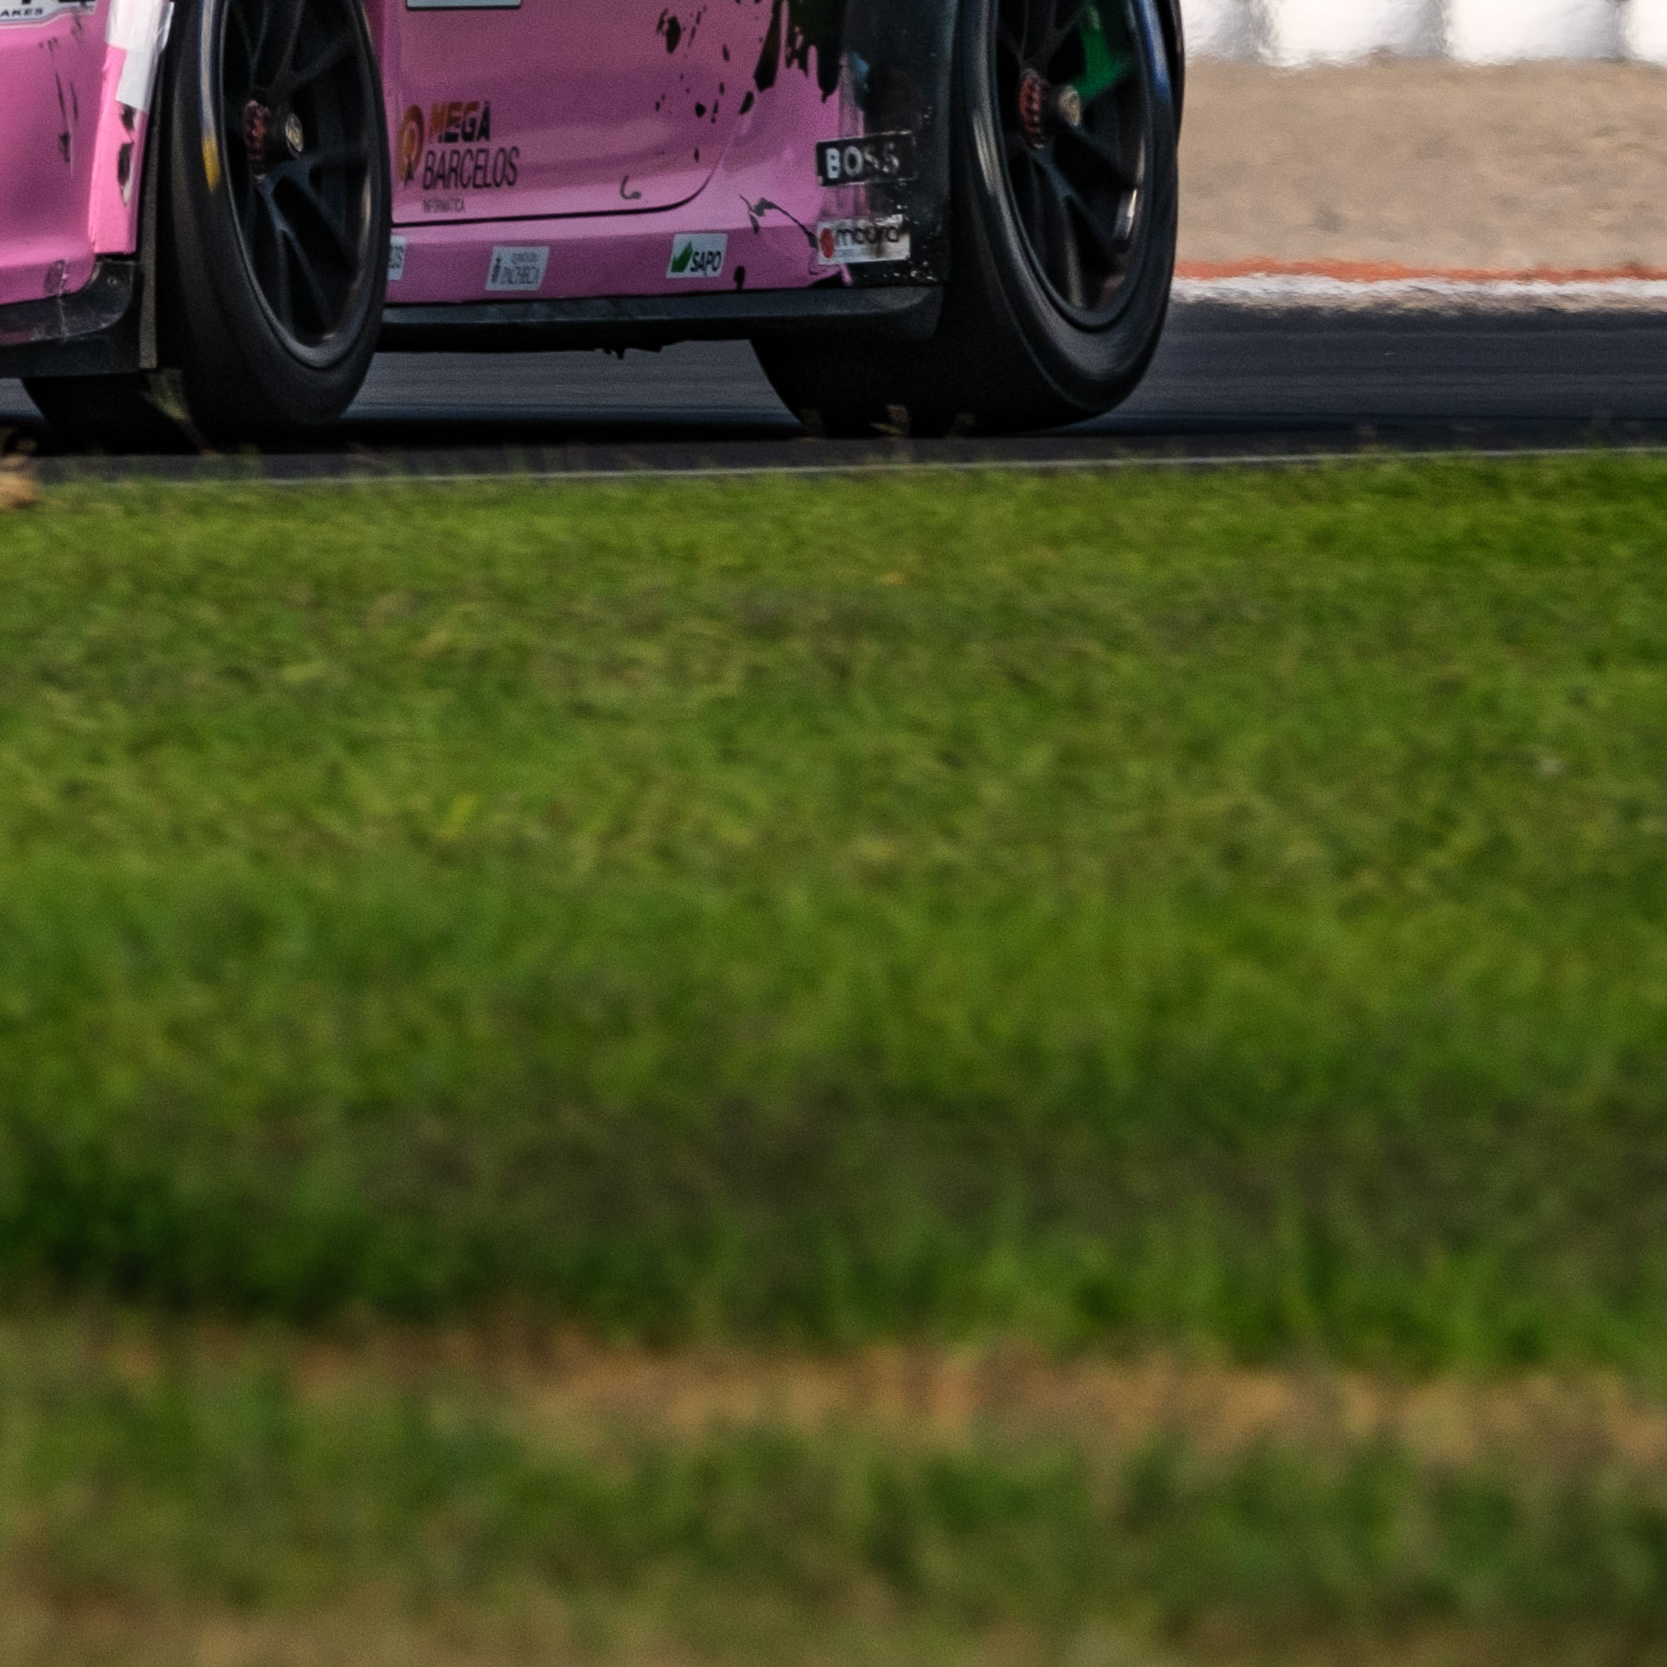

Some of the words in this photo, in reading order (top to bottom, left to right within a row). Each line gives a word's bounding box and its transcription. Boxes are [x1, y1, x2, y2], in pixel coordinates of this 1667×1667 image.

[428, 101, 491, 144] MEGA
[422, 146, 521, 191] BARCELOS
[690, 250, 722, 272] SAPO
